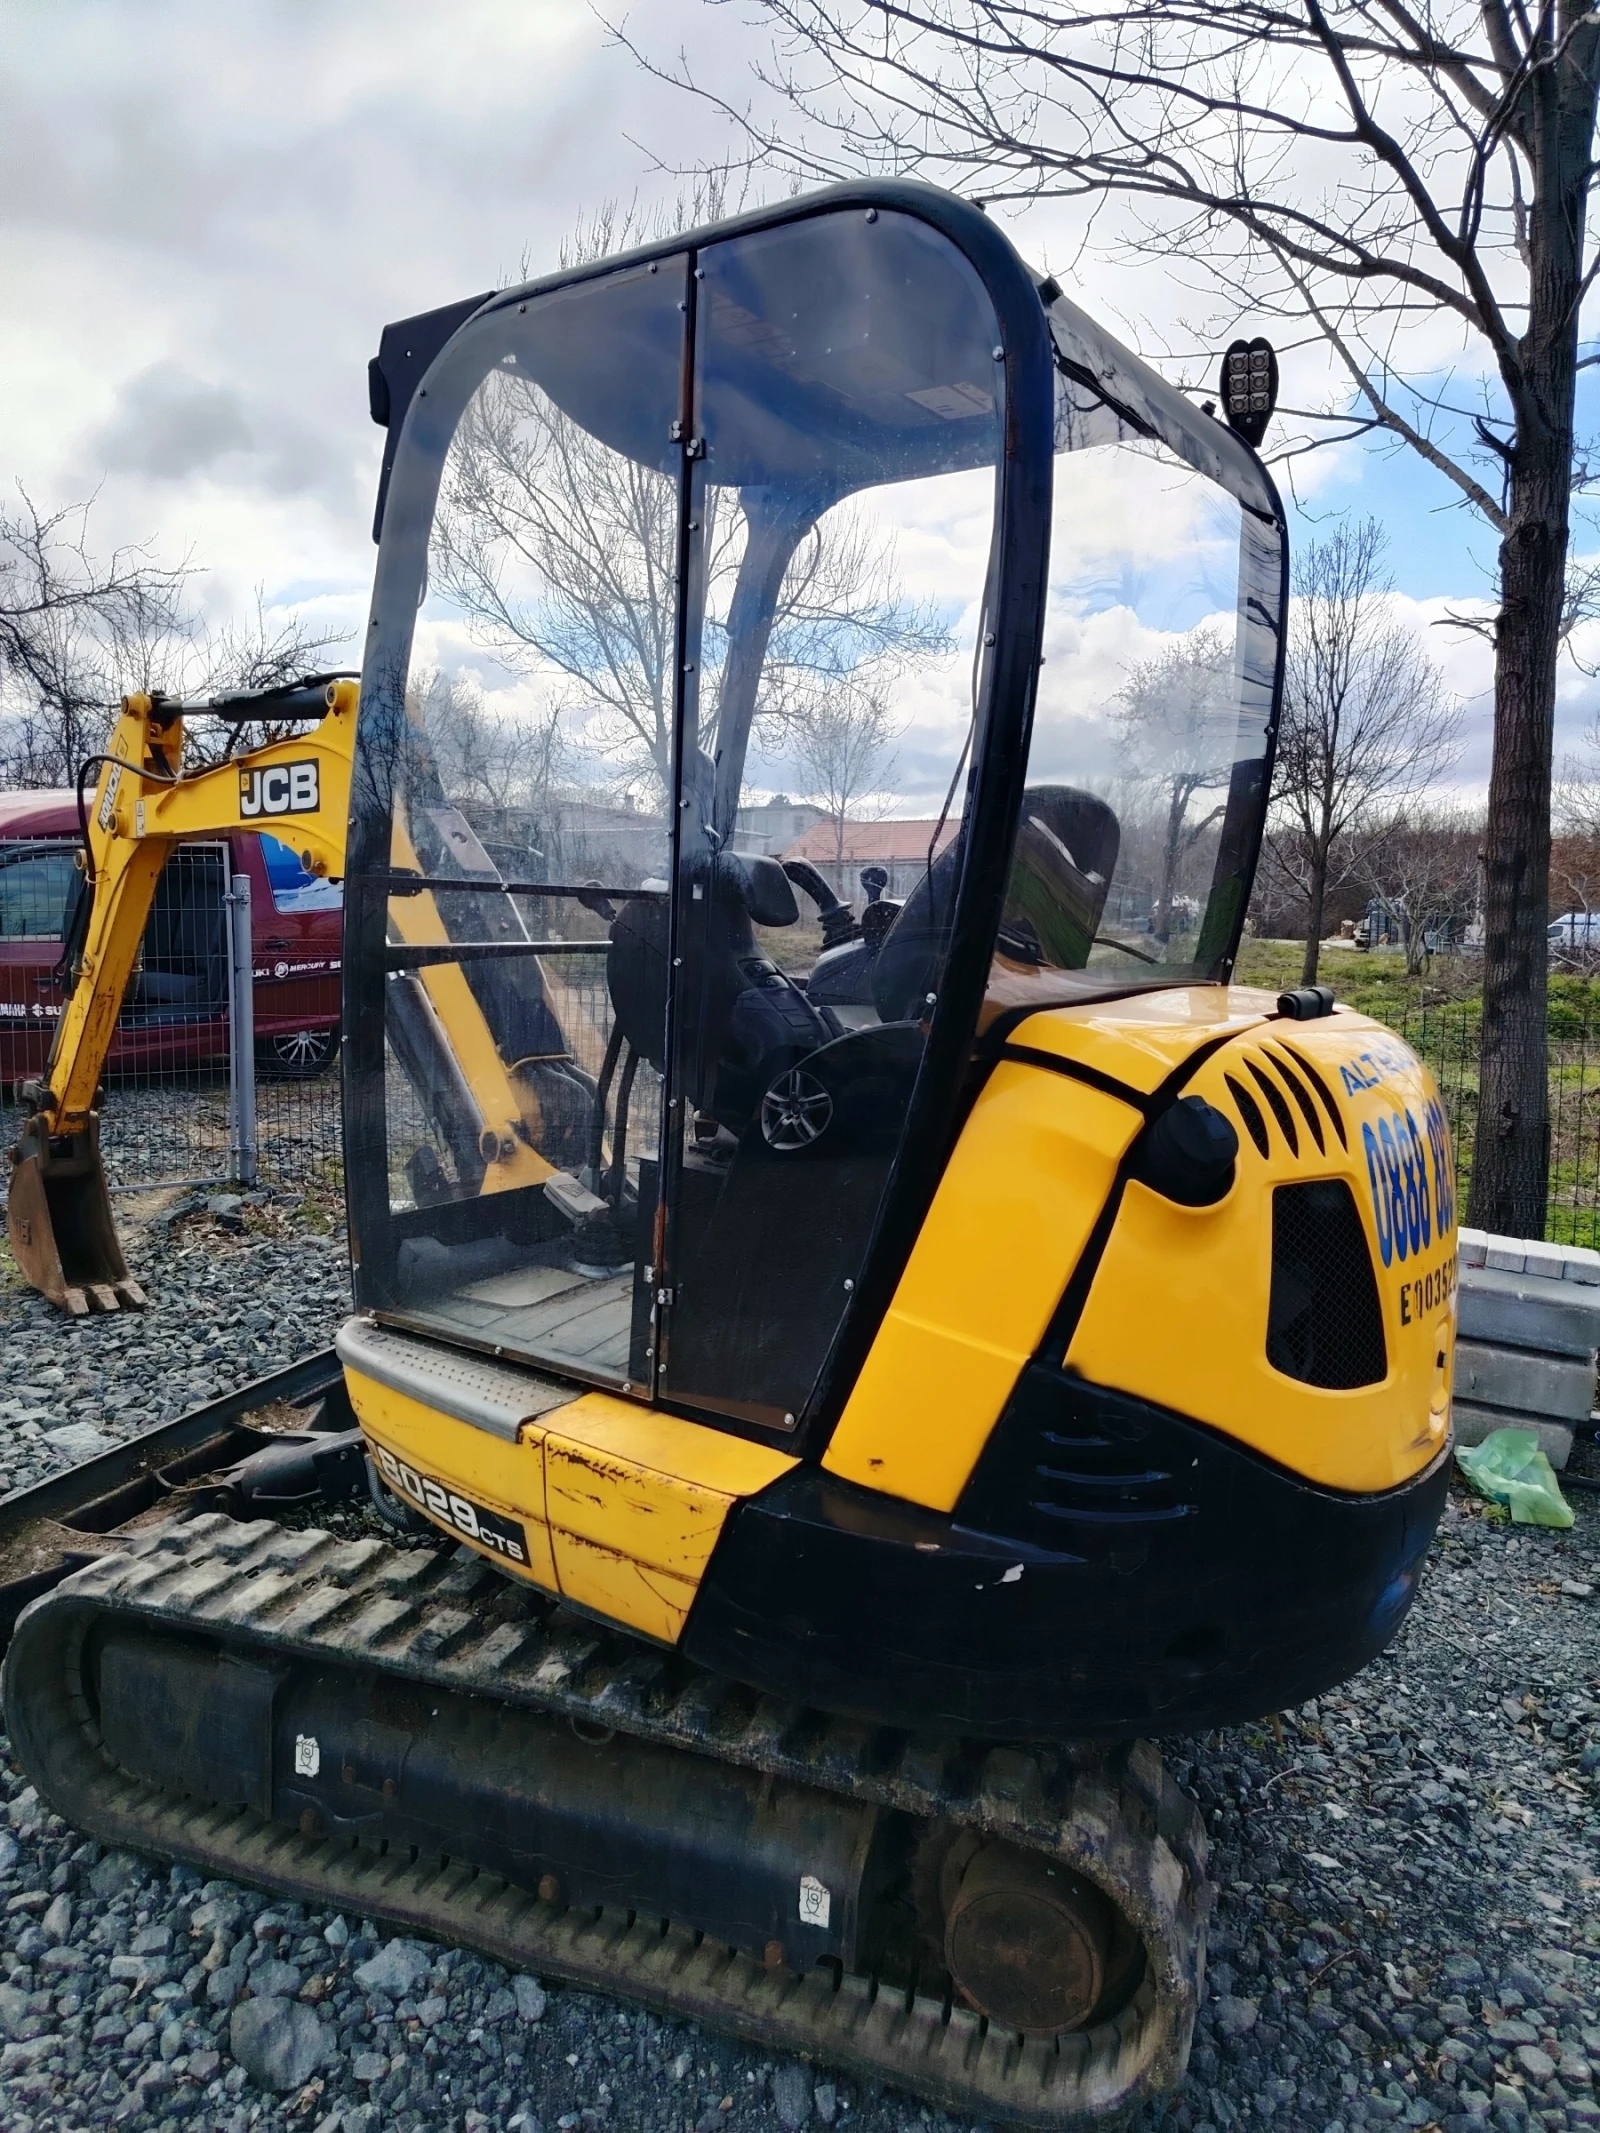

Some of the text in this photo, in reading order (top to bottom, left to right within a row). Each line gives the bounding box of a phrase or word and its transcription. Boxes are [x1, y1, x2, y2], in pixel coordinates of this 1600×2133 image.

[241, 764, 318, 815] JCB
[289, 961, 326, 972] MERCURY
[0, 1003, 26, 1017] MAHA
[1362, 1108, 1431, 1269] 0888
[378, 1446, 524, 1561] 8029 CTS
